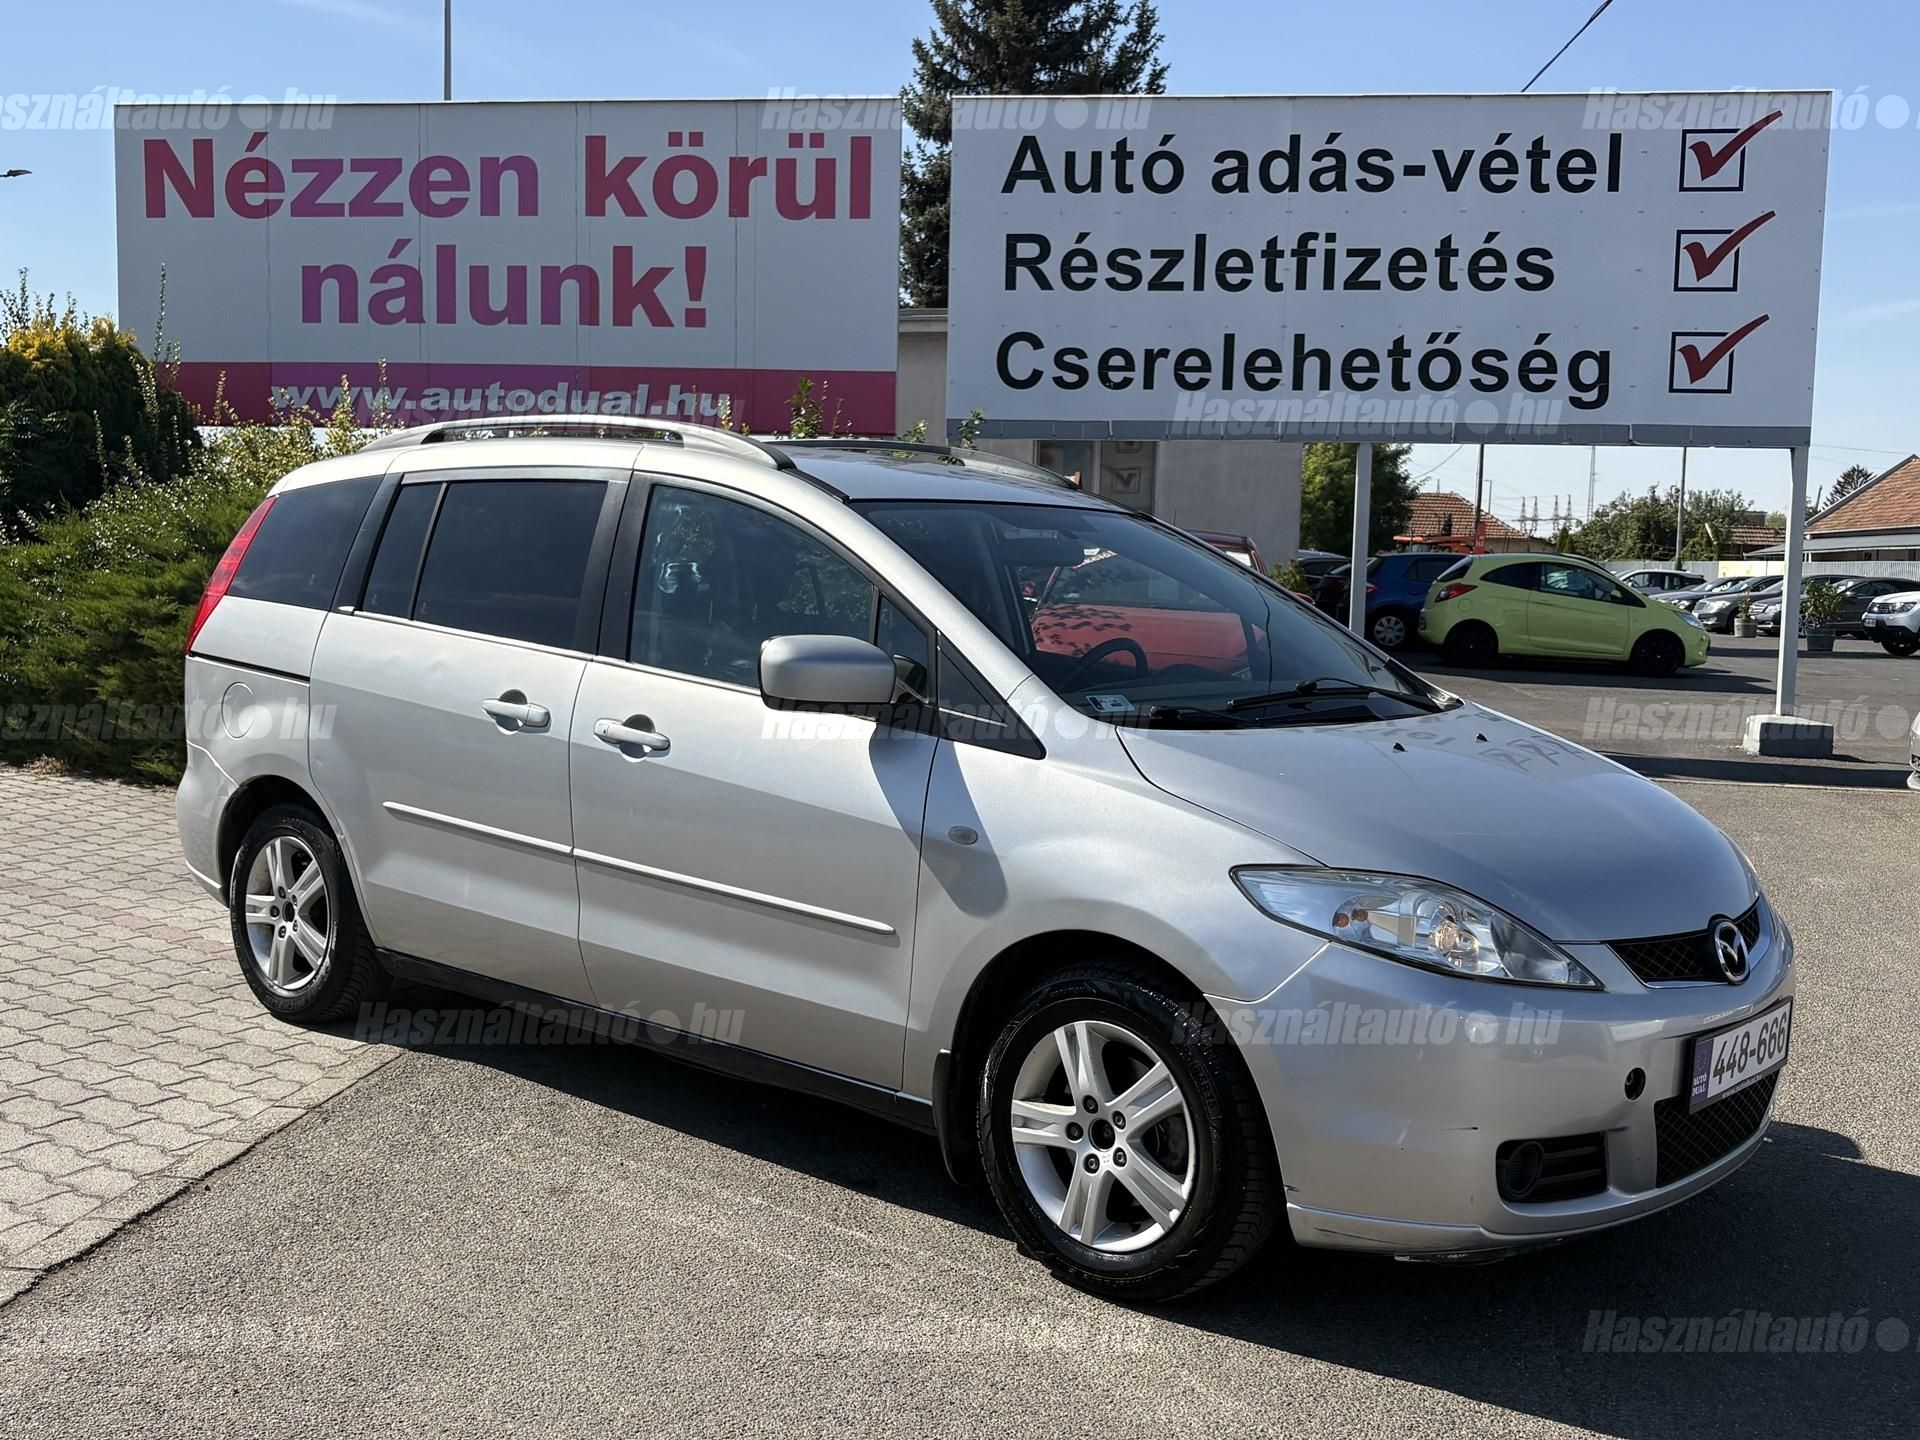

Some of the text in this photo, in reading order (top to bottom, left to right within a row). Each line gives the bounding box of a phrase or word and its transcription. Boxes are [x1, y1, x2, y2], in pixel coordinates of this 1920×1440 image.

[143, 131, 872, 221] Nézzen körül
[1000, 132, 1623, 195] Autó adás-vétel
[301, 238, 707, 328] nálunk!
[1004, 231, 1555, 293] Részletfizetés
[270, 382, 731, 417] www.autodual.hu
[996, 331, 1611, 410] Cserelehetőség
[1712, 1011, 1788, 1085] 448-666
